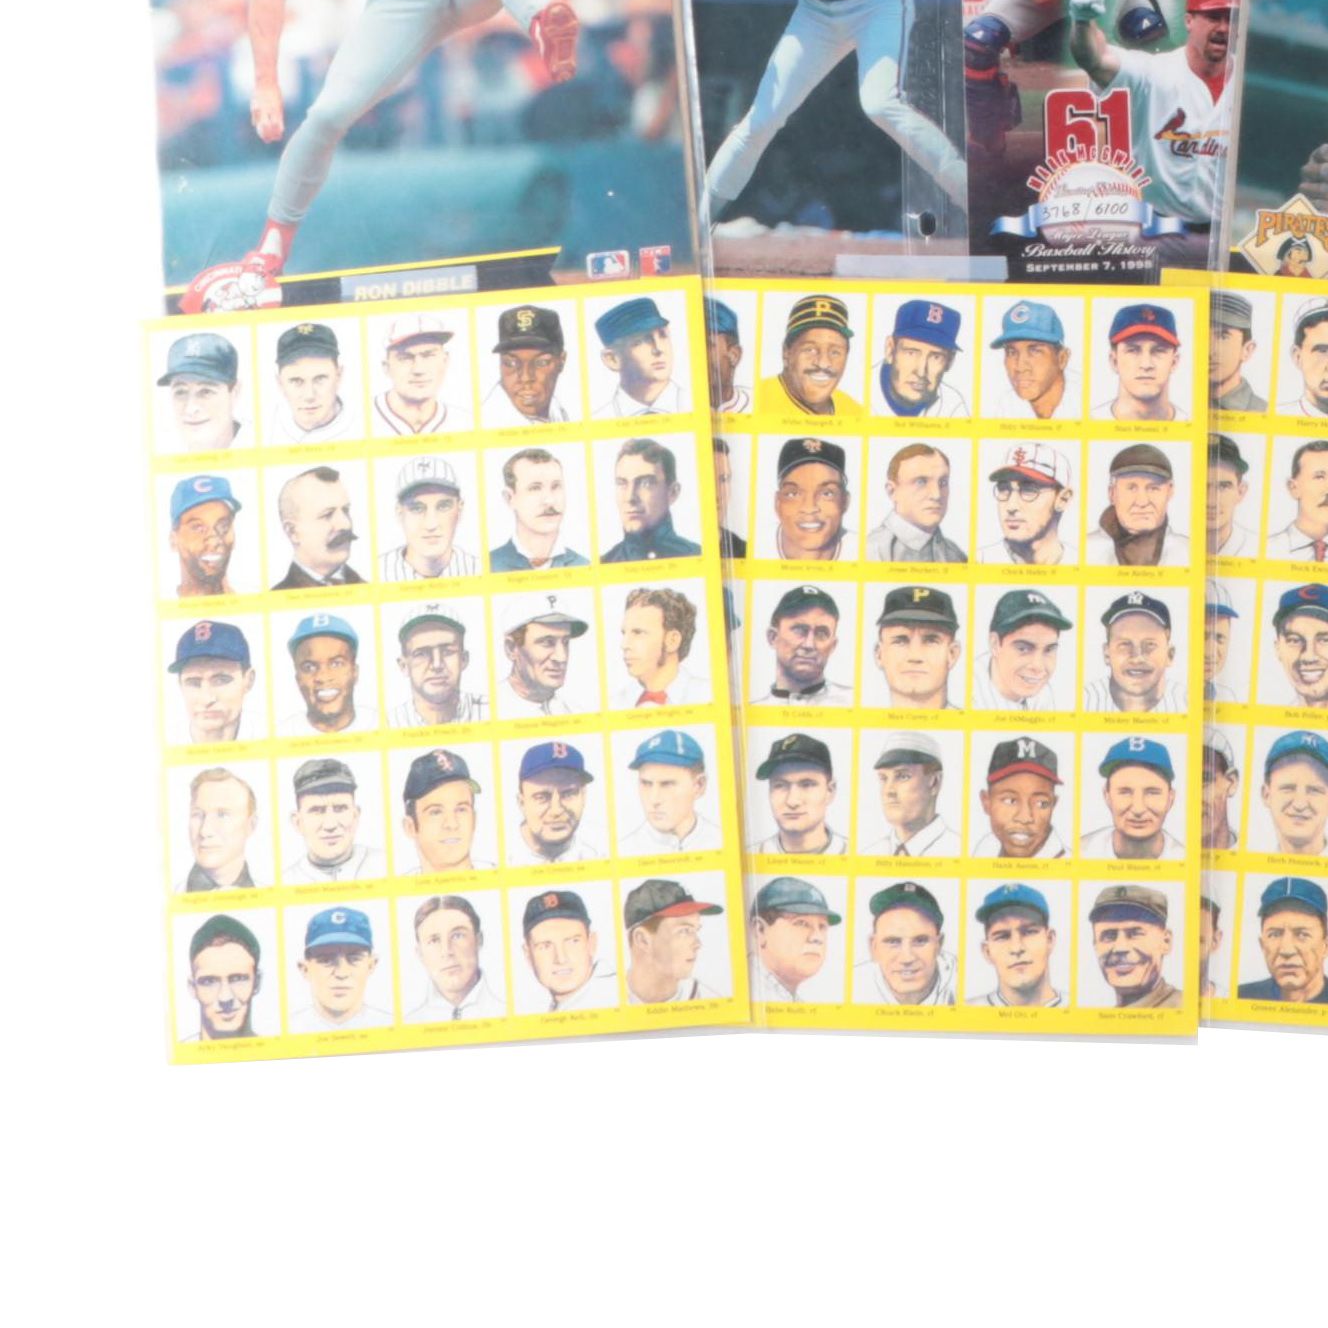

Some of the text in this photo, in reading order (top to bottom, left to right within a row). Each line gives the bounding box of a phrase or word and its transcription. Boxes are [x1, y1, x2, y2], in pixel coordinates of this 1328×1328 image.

[1044, 88, 1132, 162] 61
[1022, 241, 1156, 258] Baseball History
[353, 275, 476, 302] RON DIBBLE
